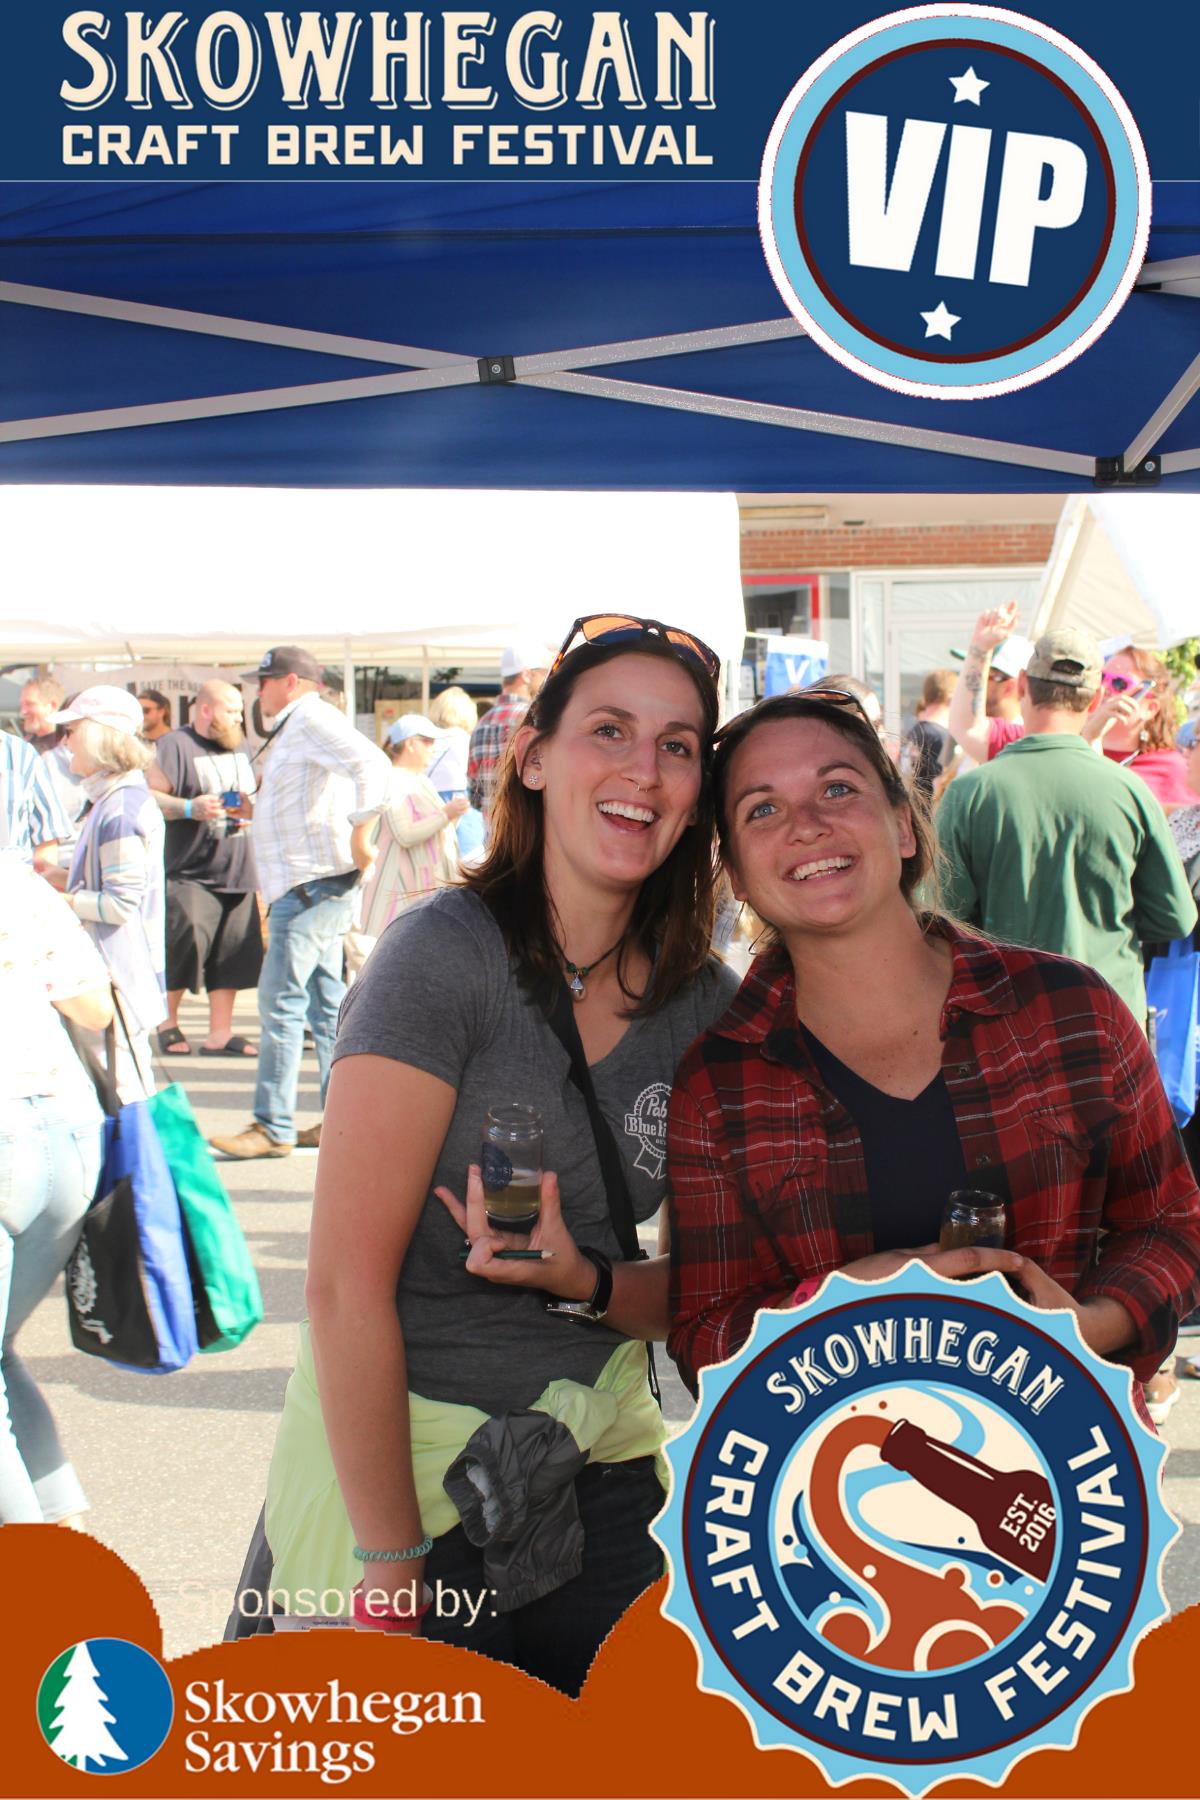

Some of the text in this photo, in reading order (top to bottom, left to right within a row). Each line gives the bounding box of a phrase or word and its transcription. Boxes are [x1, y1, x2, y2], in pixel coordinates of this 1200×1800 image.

[168, 680, 185, 691] THE
[646, 1094, 667, 1118] Pab
[629, 1117, 657, 1136] Blue
